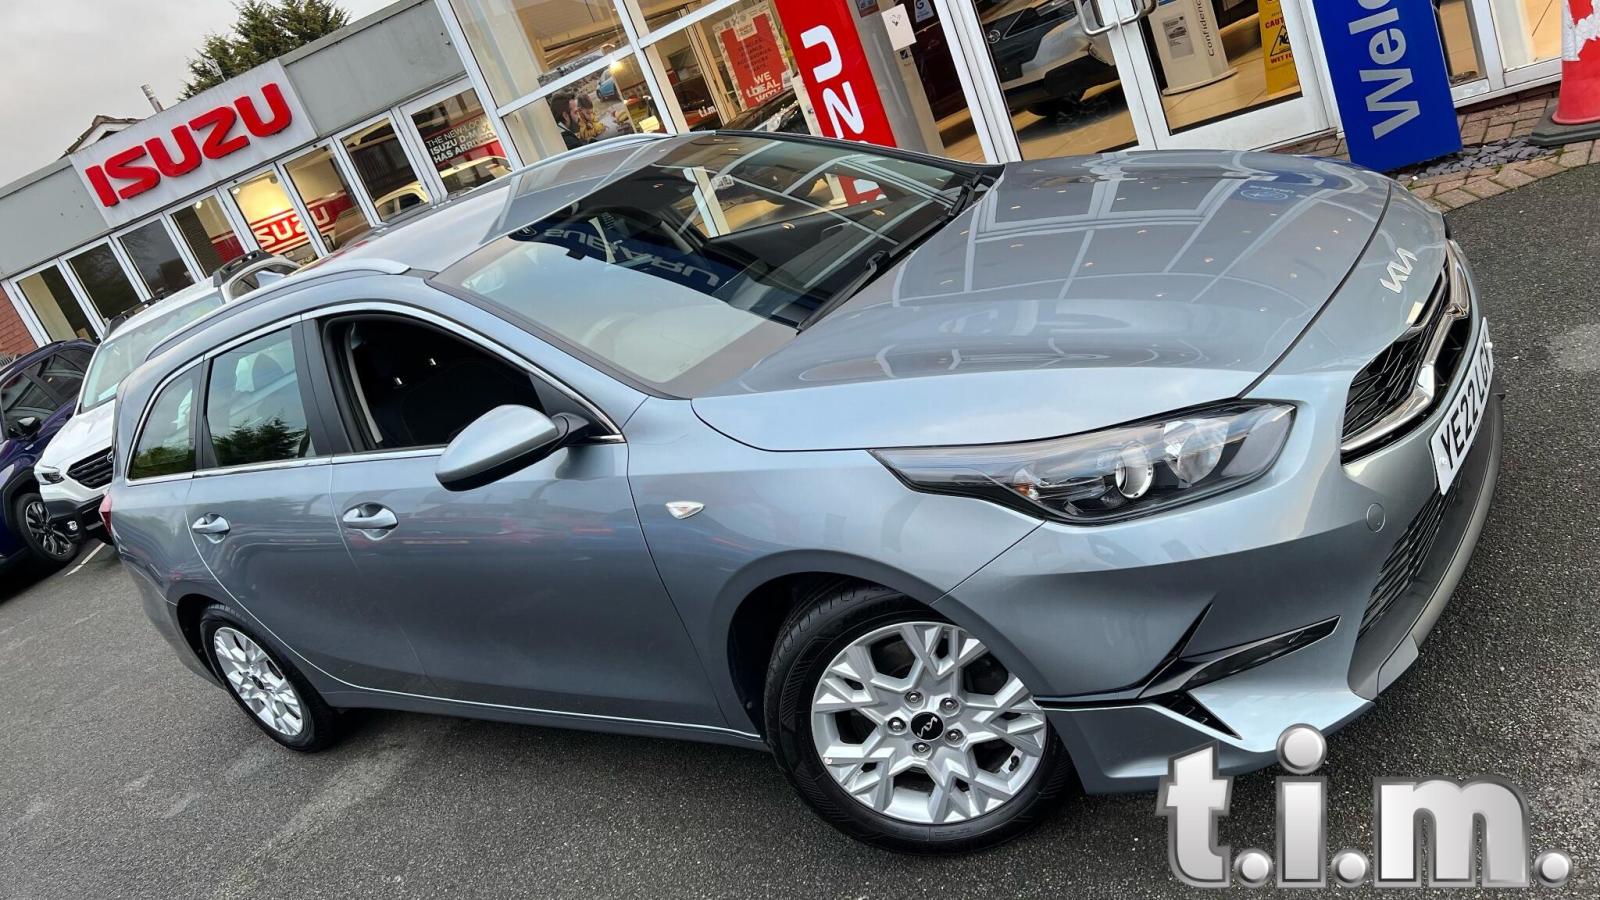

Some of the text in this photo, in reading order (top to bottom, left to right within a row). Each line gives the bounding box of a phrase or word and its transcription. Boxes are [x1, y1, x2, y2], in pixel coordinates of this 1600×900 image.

[753, 71, 772, 84] WE
[85, 83, 293, 207] ISUZU
[426, 138, 442, 148] THE
[430, 139, 457, 156] ISUZU
[433, 151, 453, 164] HAS
[254, 206, 330, 247] SUZU
[1440, 379, 1479, 470] YE22
